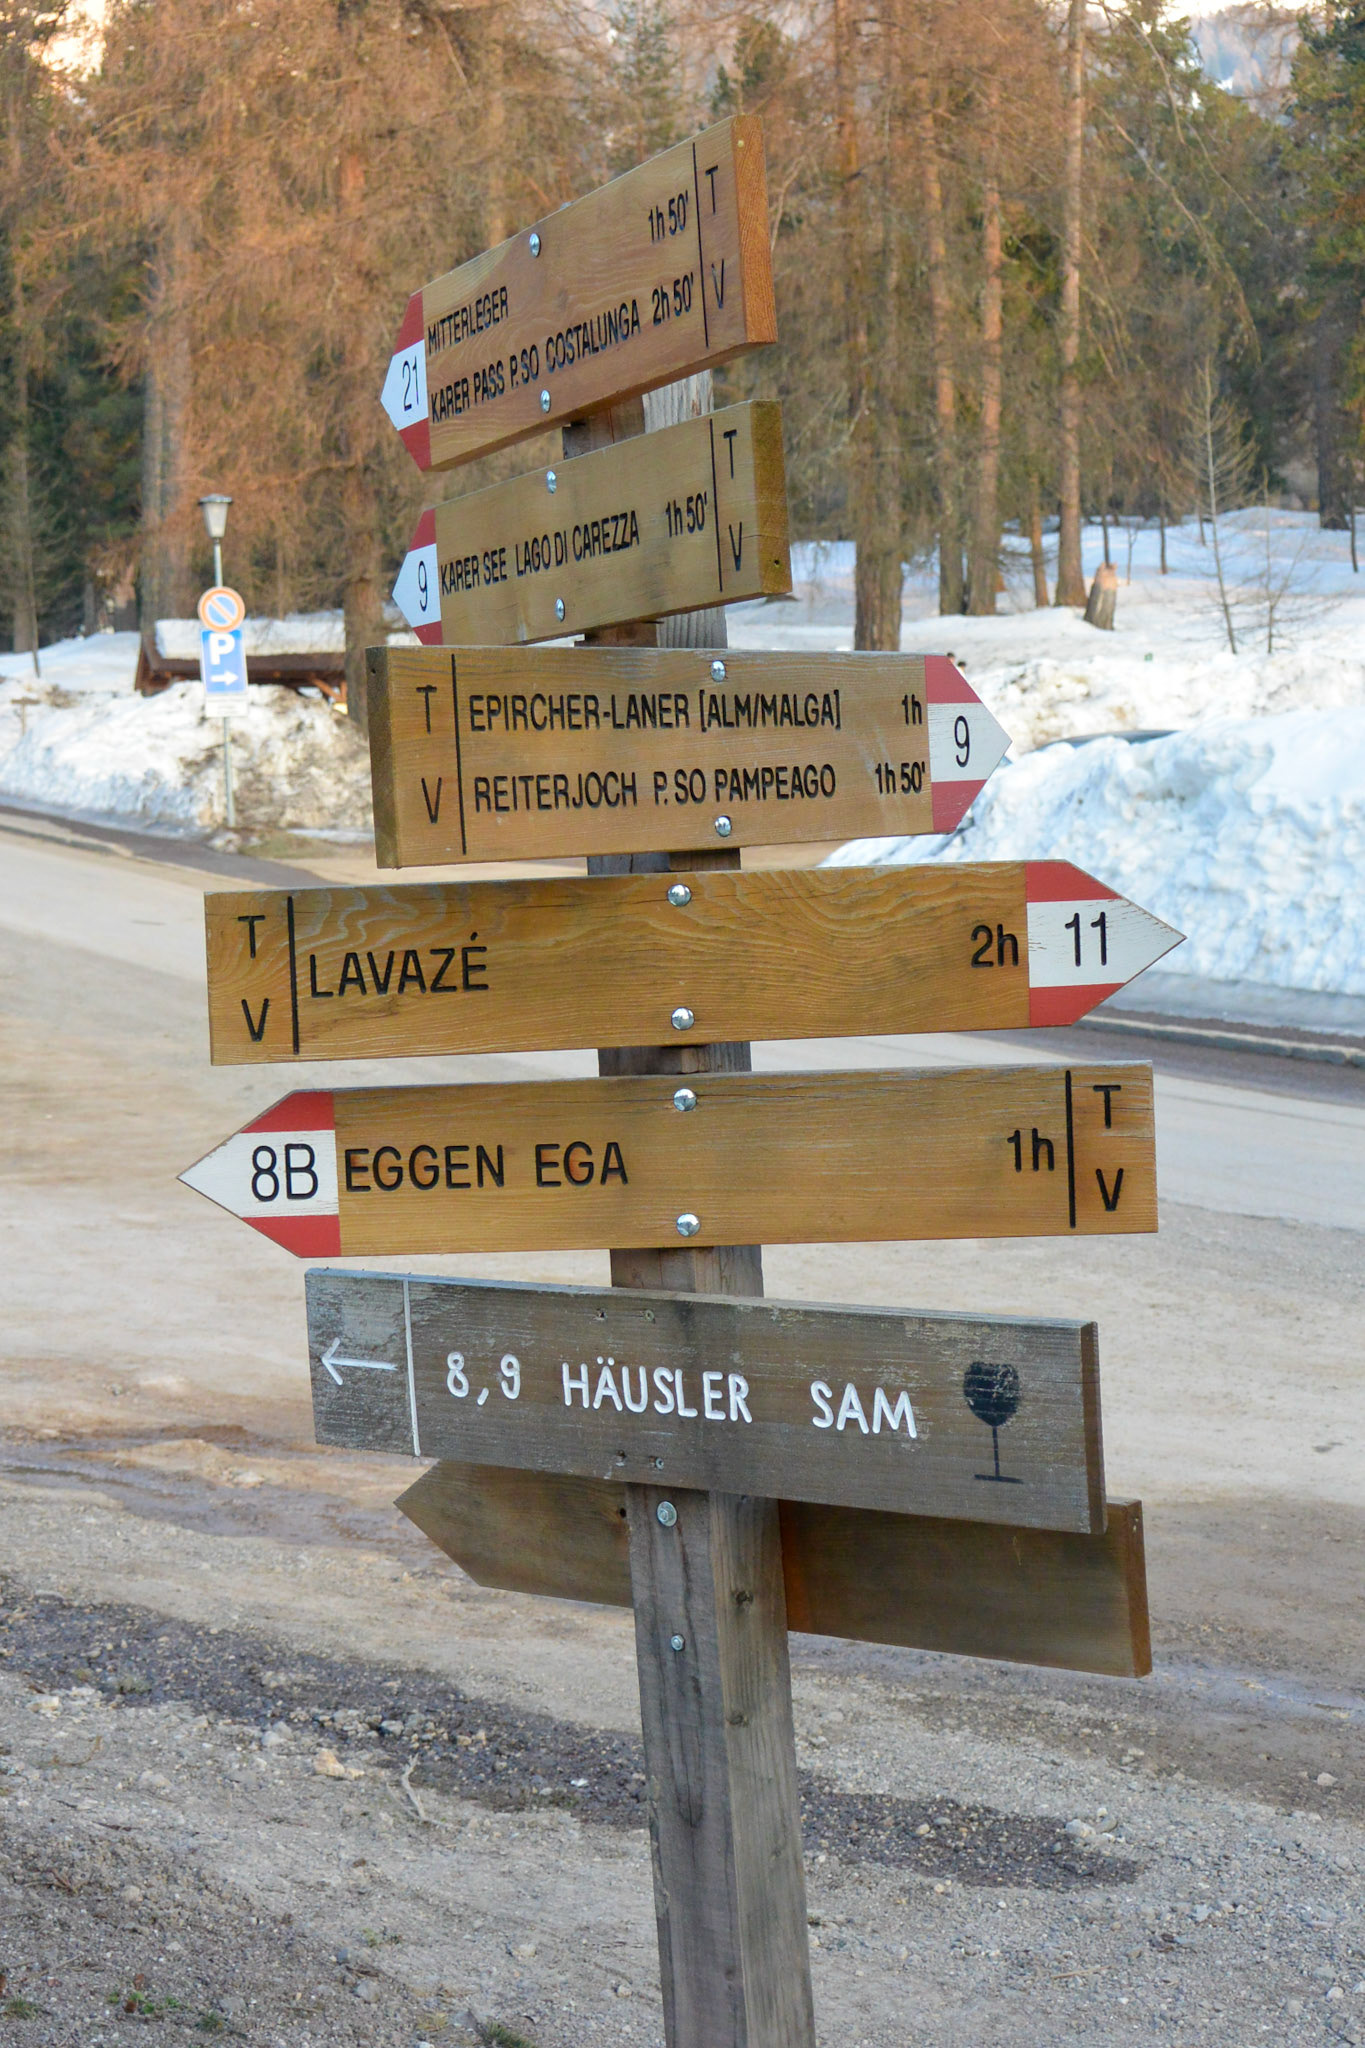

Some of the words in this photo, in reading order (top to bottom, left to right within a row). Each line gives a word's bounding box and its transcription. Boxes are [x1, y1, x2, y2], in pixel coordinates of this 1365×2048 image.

[705, 165, 719, 215] T
[428, 286, 509, 357] MITTERLEGER
[648, 205, 666, 244] 1h
[668, 189, 690, 236] 50'
[711, 258, 725, 309] V
[430, 378, 470, 424] KARER
[473, 360, 505, 406] PASS
[545, 299, 642, 374] COSTALUNGA
[651, 285, 671, 327] 2h
[673, 271, 695, 319] 50'
[401, 354, 421, 413] 21
[723, 429, 738, 480] T
[440, 554, 480, 597] KARER
[482, 547, 508, 585] SEE
[515, 533, 552, 577] LAGO
[555, 530, 569, 568] DI
[572, 510, 640, 562] CAREZZA
[665, 499, 684, 539] 1h
[686, 490, 709, 534] 50'
[728, 521, 743, 573] V
[417, 560, 428, 612] 9
[209, 633, 235, 665] P
[416, 684, 437, 735] T
[470, 692, 690, 732] EPIRCHER-LANER
[901, 696, 923, 727] 1h
[953, 715, 971, 768] 9
[421, 776, 443, 825] V
[474, 769, 637, 814] REITERJOCH
[715, 763, 837, 804] PAMPEAGO
[875, 763, 898, 796] 1h
[900, 761, 927, 795] 50'
[237, 915, 266, 960] T
[309, 931, 490, 1000] LAVAZÉ
[970, 923, 1020, 969] 2h
[1064, 912, 1110, 967] 11
[240, 997, 270, 1043] V
[1092, 1084, 1122, 1129] T
[251, 1143, 319, 1202] 8B
[344, 1144, 506, 1194] EGGEN
[534, 1141, 629, 1188] EGA
[1006, 1128, 1055, 1173] 1h
[1094, 1167, 1125, 1213] V
[562, 1356, 753, 1424] HÄUSLER
[811, 1379, 919, 1439] SAM
